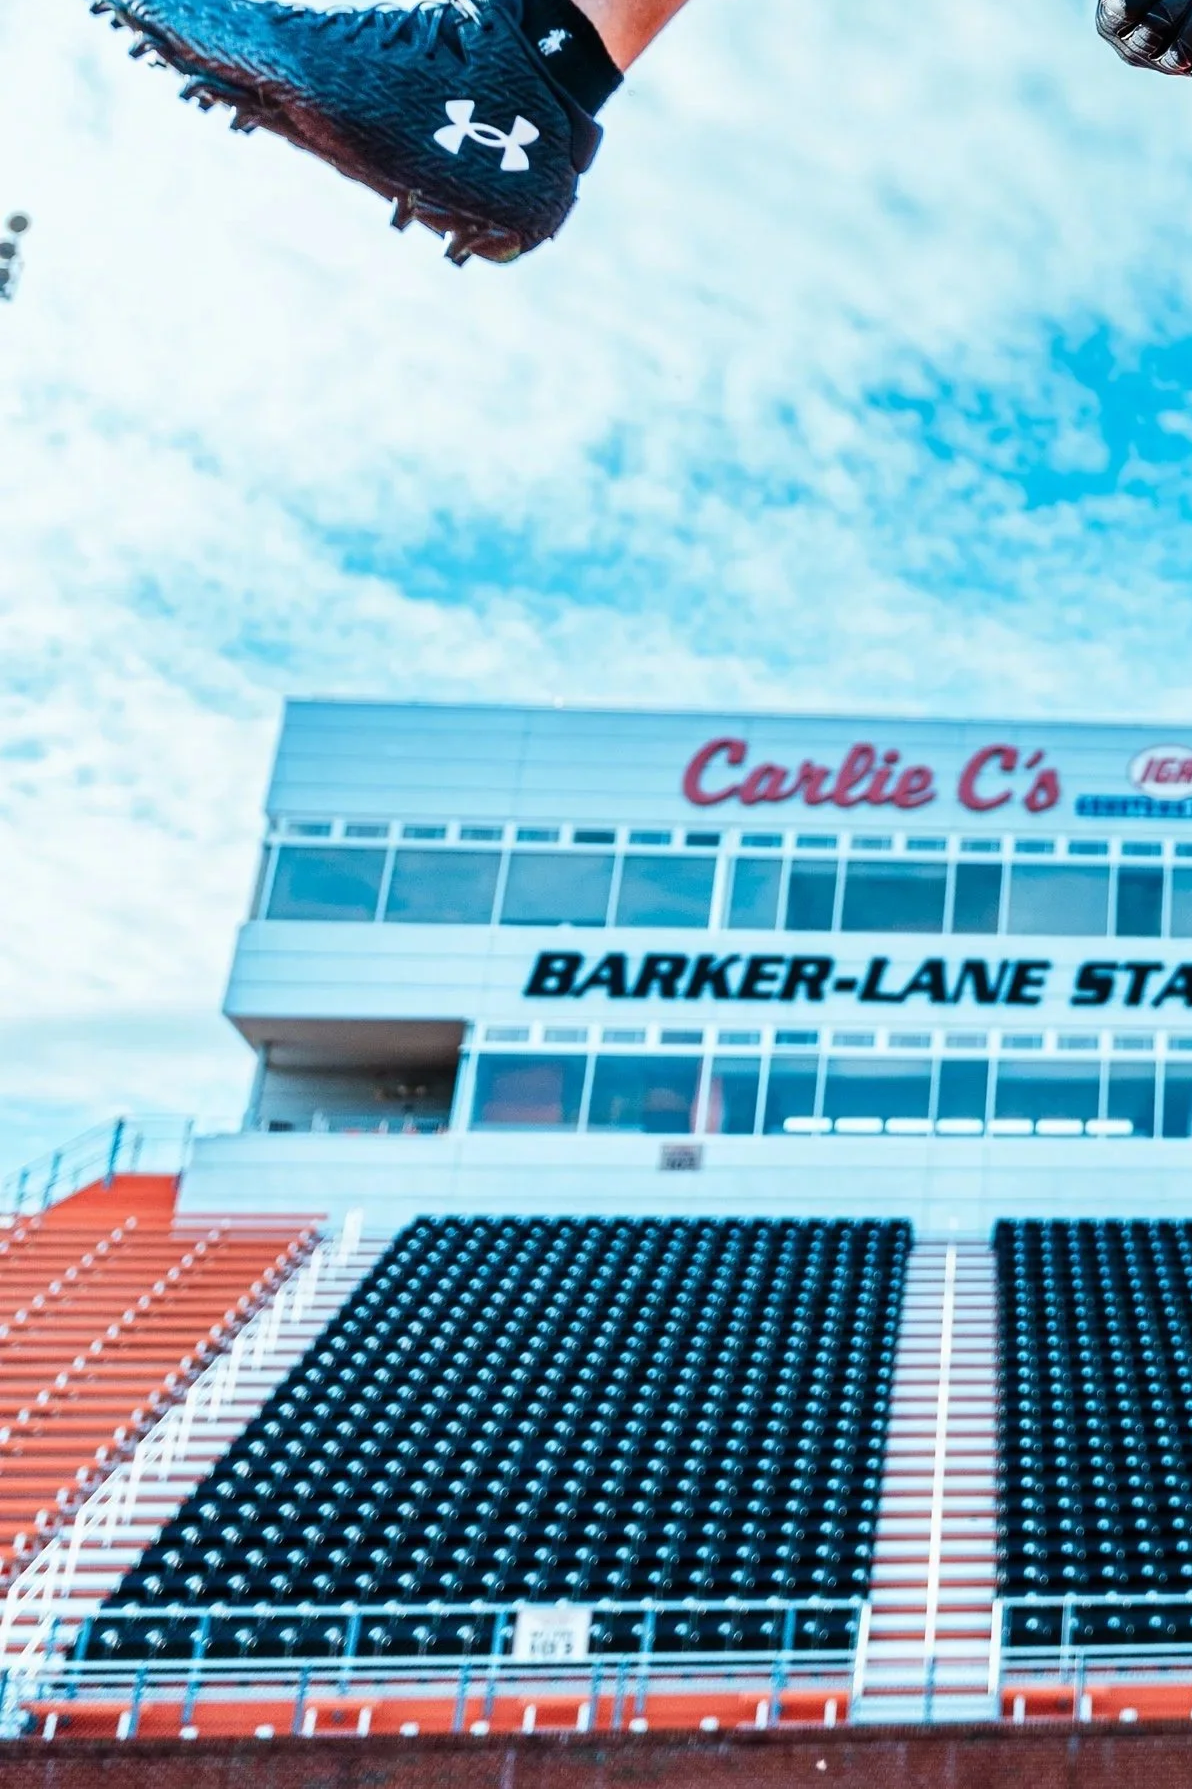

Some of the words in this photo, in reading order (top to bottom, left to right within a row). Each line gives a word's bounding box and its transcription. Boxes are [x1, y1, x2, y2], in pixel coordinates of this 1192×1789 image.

[682, 736, 936, 810] Carlie
[957, 743, 1061, 813] C's
[522, 951, 1052, 1006] BARKER-LANE
